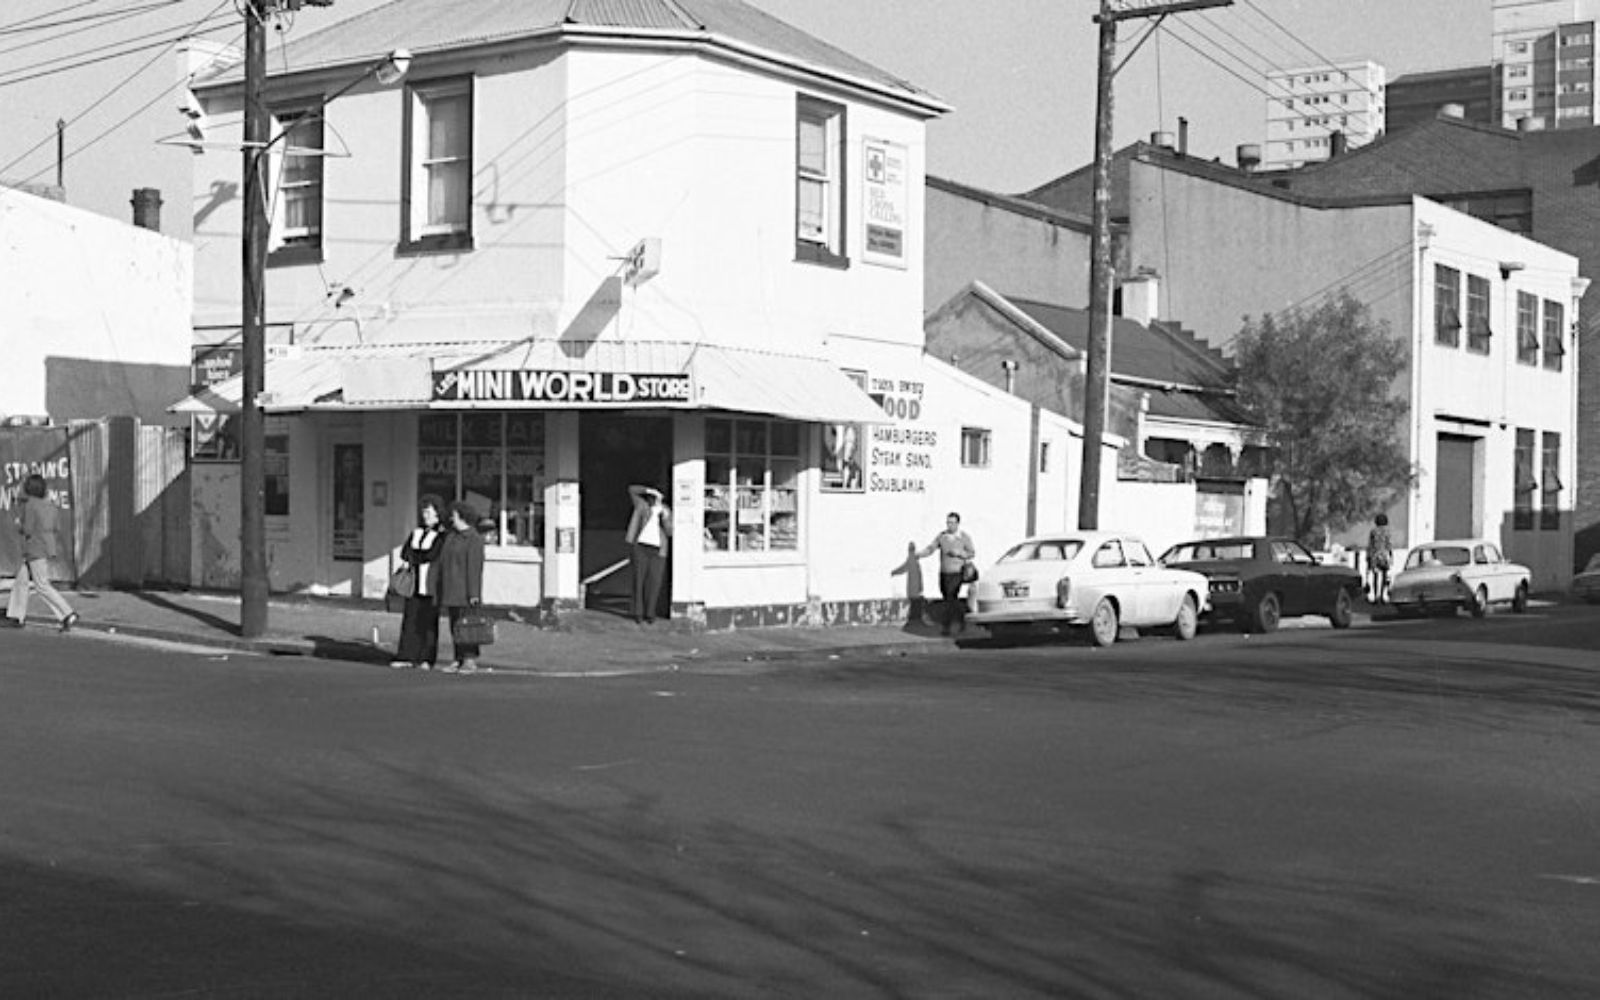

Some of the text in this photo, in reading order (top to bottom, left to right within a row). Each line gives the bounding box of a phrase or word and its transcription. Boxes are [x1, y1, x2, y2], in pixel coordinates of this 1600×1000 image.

[457, 371, 512, 400] MINI
[520, 372, 637, 401] WORLD
[638, 377, 690, 399] STORE
[884, 397, 921, 420] OOD
[872, 428, 937, 446] HAMBURGERS
[871, 446, 901, 466] STEAK
[0, 485, 20, 511] NY
